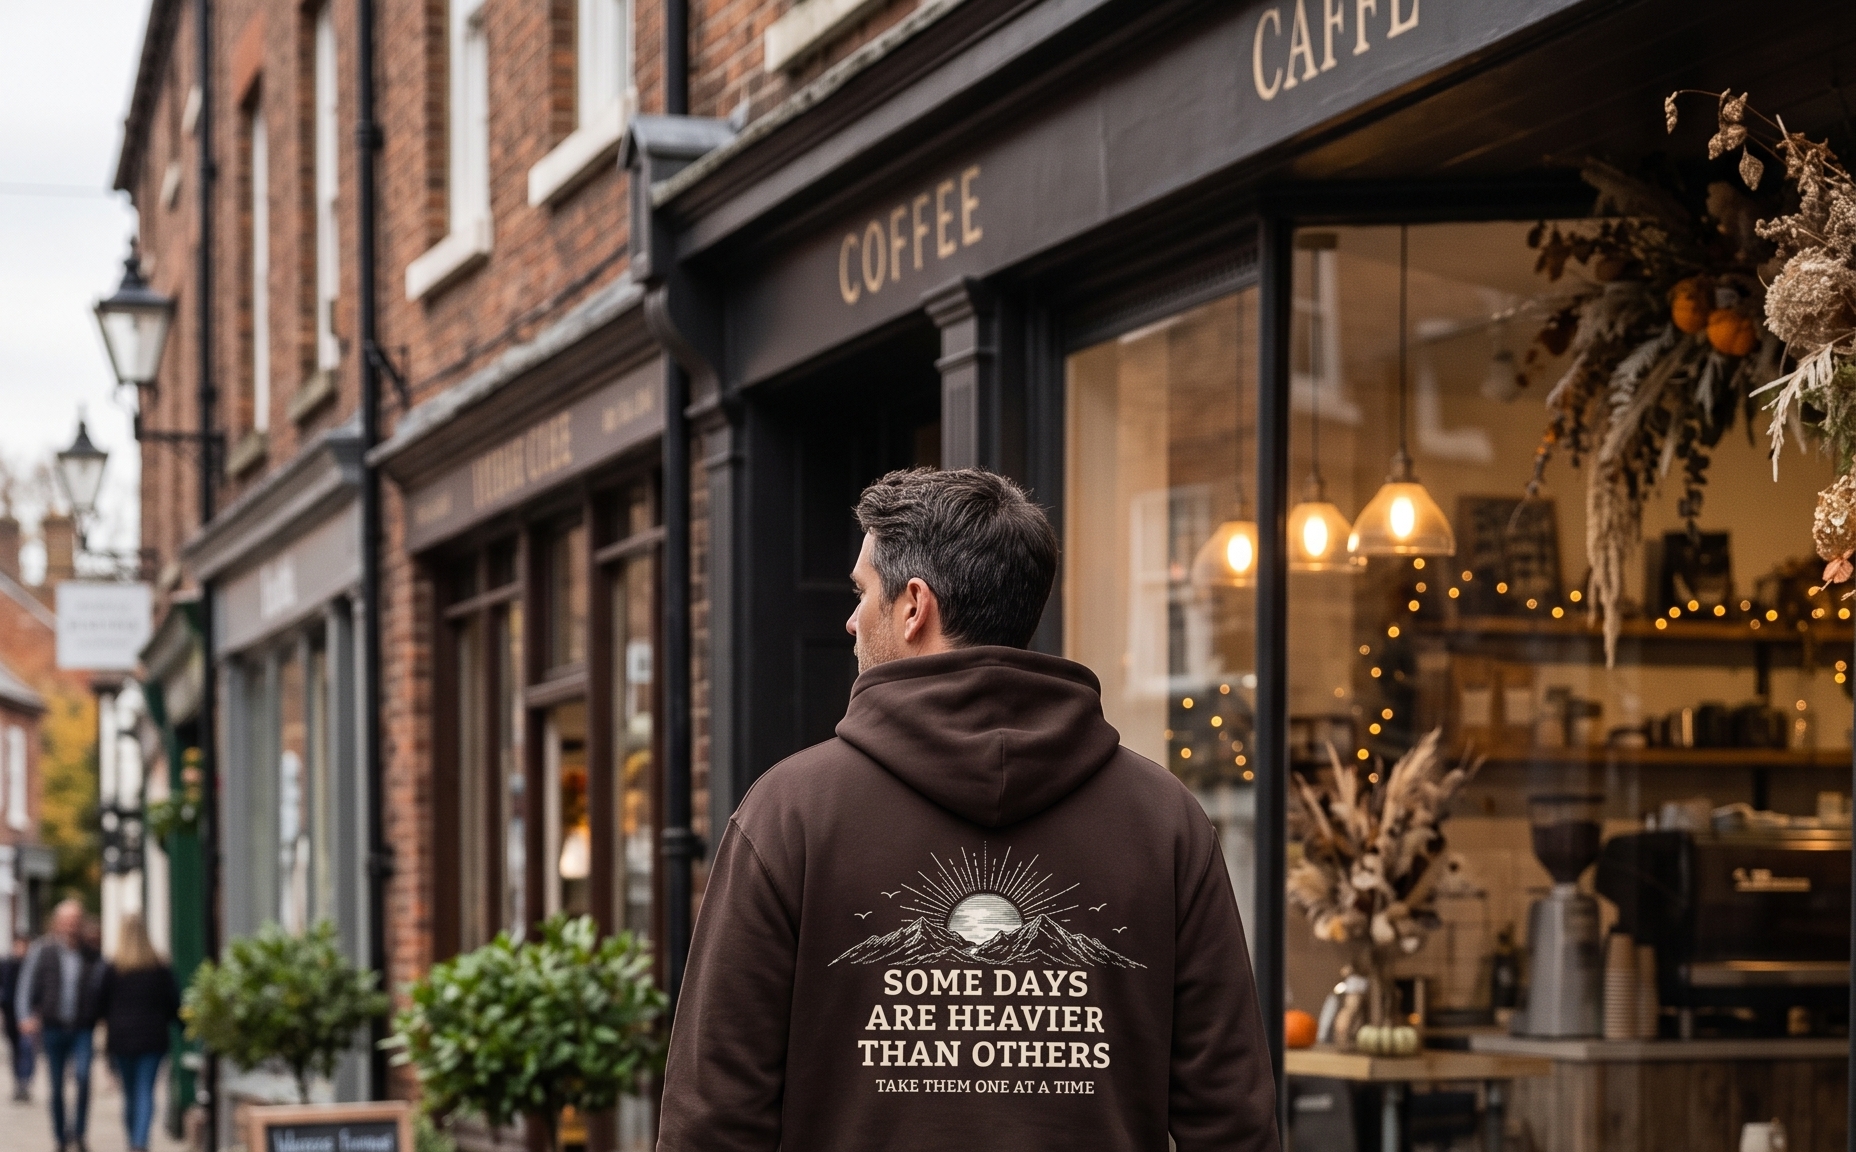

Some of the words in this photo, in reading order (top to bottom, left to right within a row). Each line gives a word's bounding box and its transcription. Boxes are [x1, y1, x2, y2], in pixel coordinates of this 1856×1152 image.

[838, 163, 984, 306] COFFEE
[883, 969, 983, 996] SOME
[993, 970, 1088, 997] DAYS
[864, 1004, 937, 1031] ARE
[947, 1005, 1105, 1033] HEAVIER
[857, 1040, 962, 1067] THAN
[972, 1041, 1111, 1069] OTHERS
[875, 1079, 919, 1093] TAKE
[922, 1079, 971, 1093] THEM
[975, 1080, 1010, 1094] ONE
[1013, 1080, 1035, 1094] AT
[1038, 1080, 1051, 1094] A
[1053, 1081, 1095, 1095] TIME
